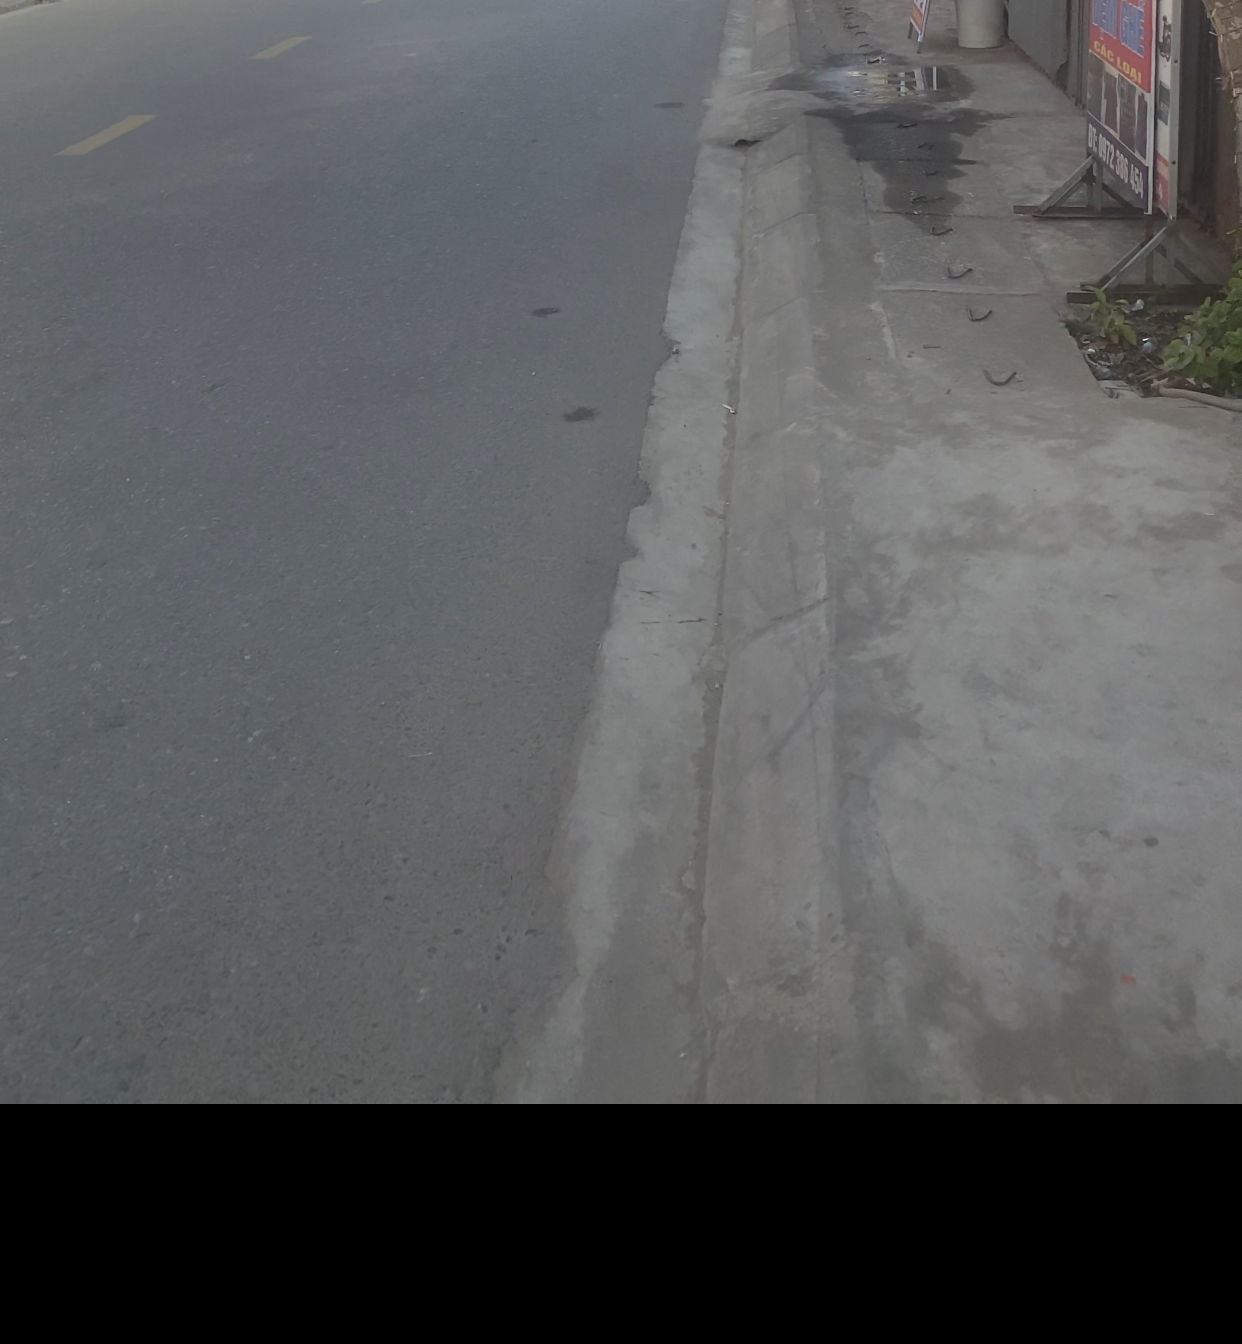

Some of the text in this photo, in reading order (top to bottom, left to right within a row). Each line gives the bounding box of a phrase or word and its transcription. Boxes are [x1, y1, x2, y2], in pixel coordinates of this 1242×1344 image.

[1093, 40, 1142, 84] CÁC LOẠI
[1098, 133, 1114, 170] 0972
[1130, 164, 1144, 199] 454
